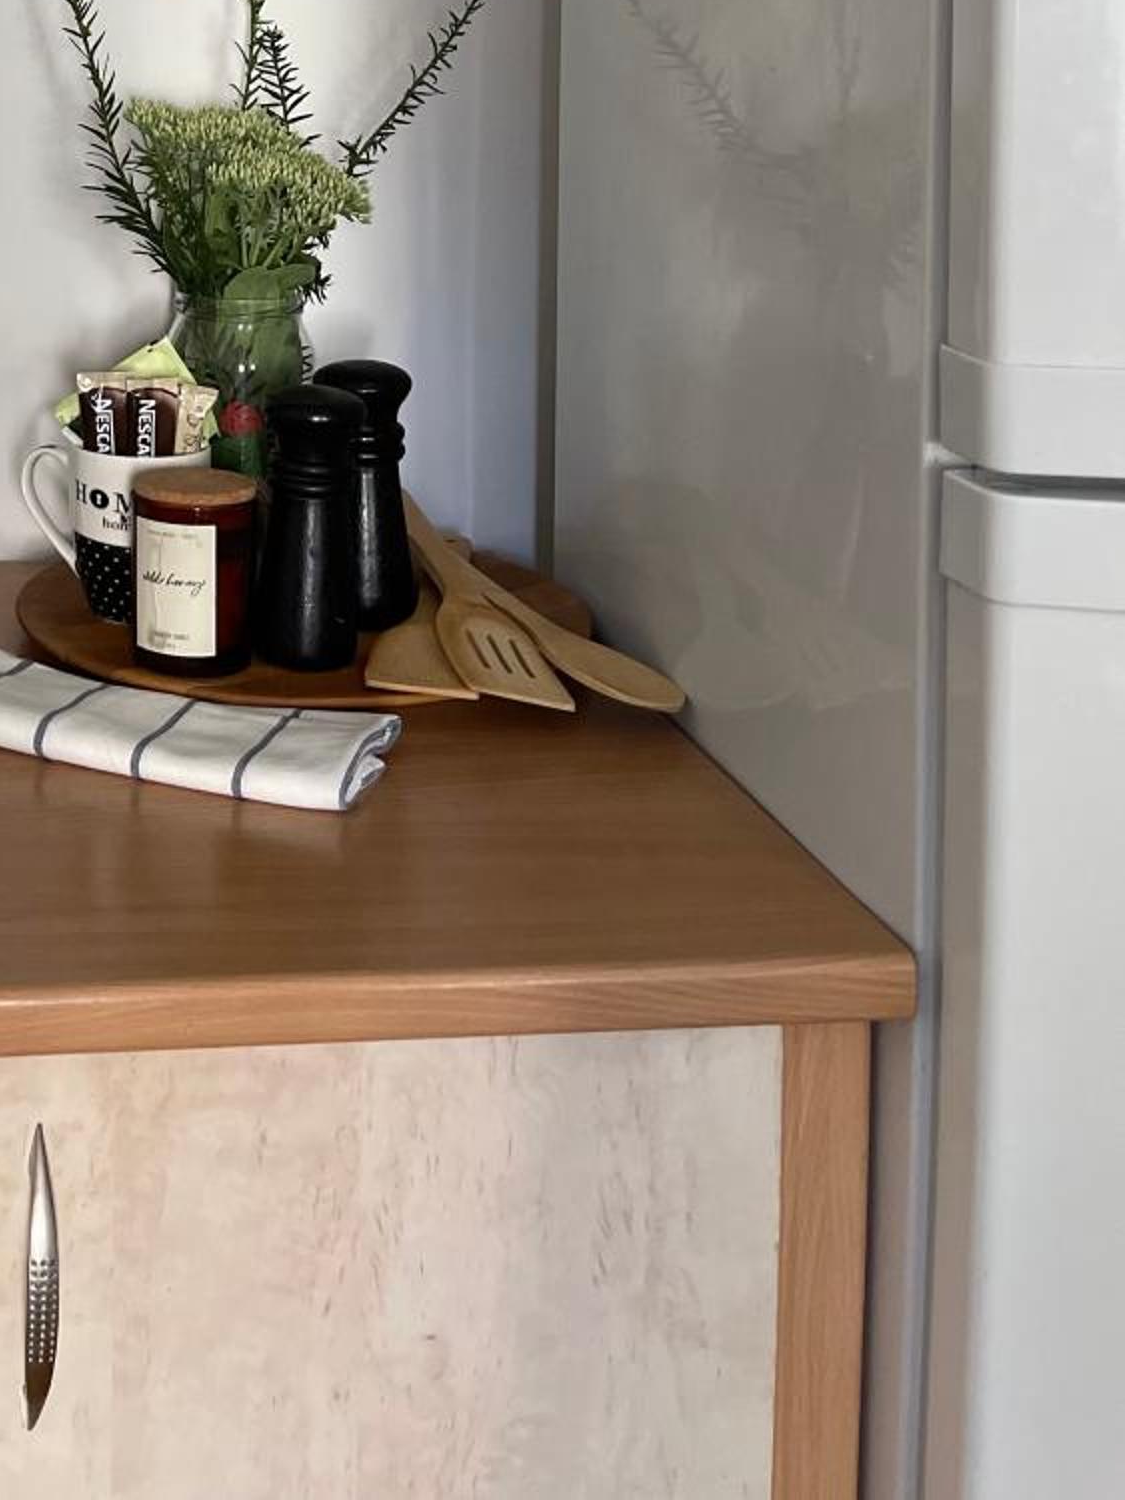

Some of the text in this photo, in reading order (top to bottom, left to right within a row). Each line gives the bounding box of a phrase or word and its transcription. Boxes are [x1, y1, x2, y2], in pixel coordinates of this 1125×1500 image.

[94, 398, 114, 454] NESCA
[137, 398, 156, 457] NESCA
[75, 479, 129, 513] HOM
